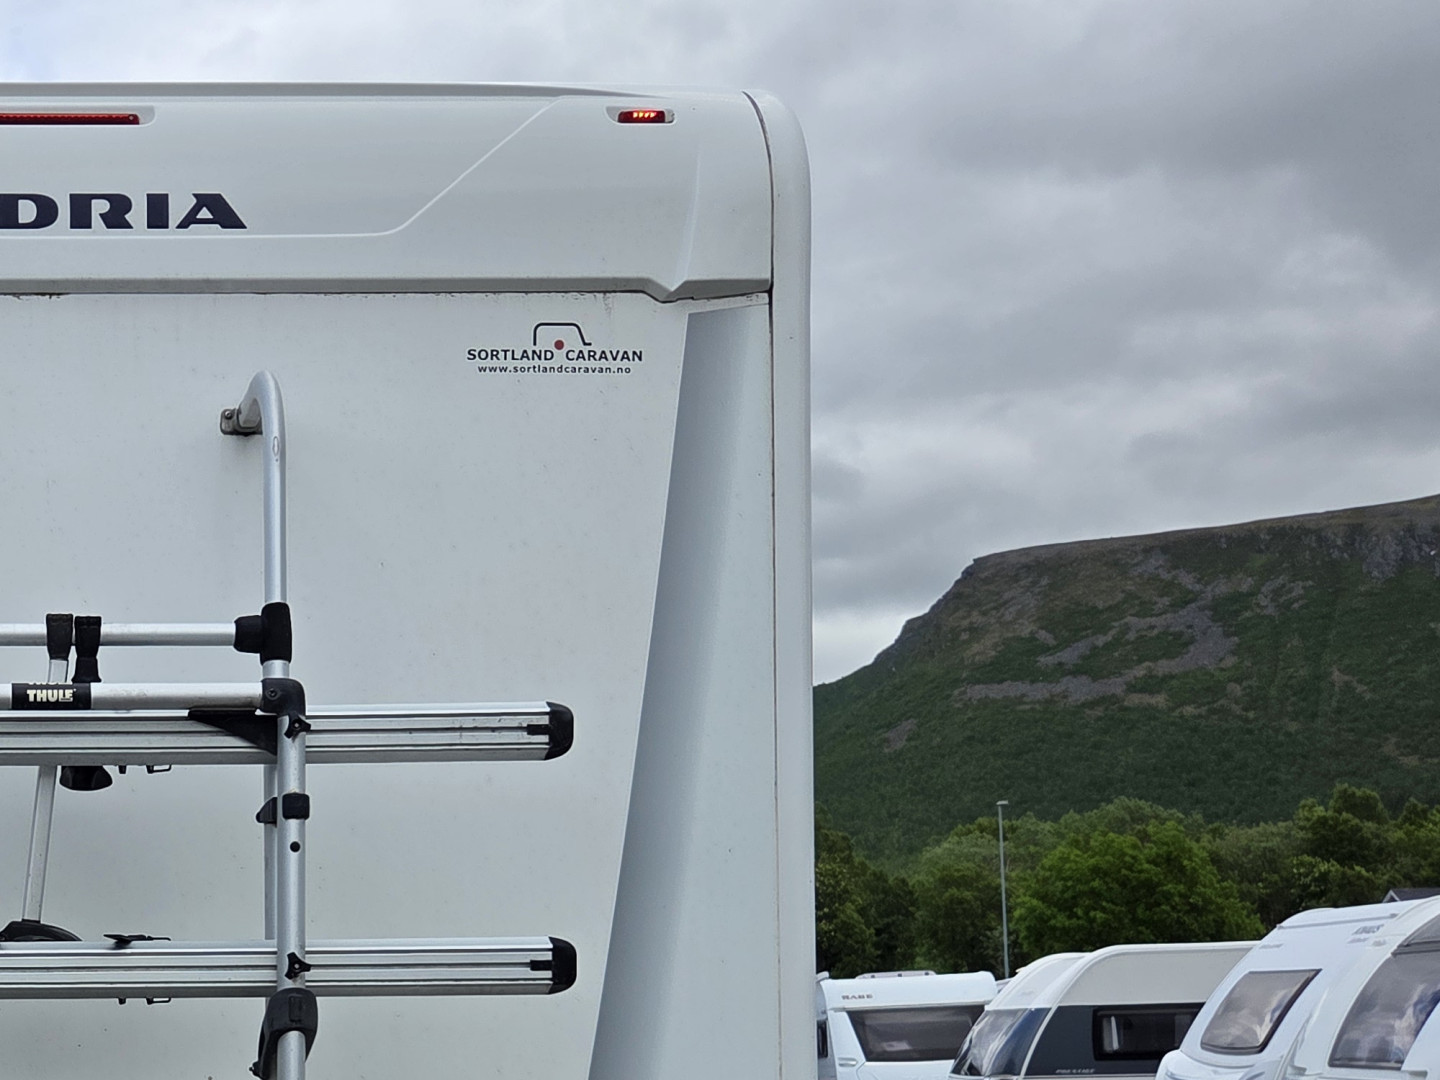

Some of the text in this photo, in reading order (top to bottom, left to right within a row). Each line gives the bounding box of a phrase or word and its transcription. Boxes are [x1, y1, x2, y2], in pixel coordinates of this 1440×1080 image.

[466, 349, 643, 362] SORTLAND CARAVAN
[477, 364, 632, 374] www.sortlandcaravan.no
[27, 689, 74, 702] THULE
